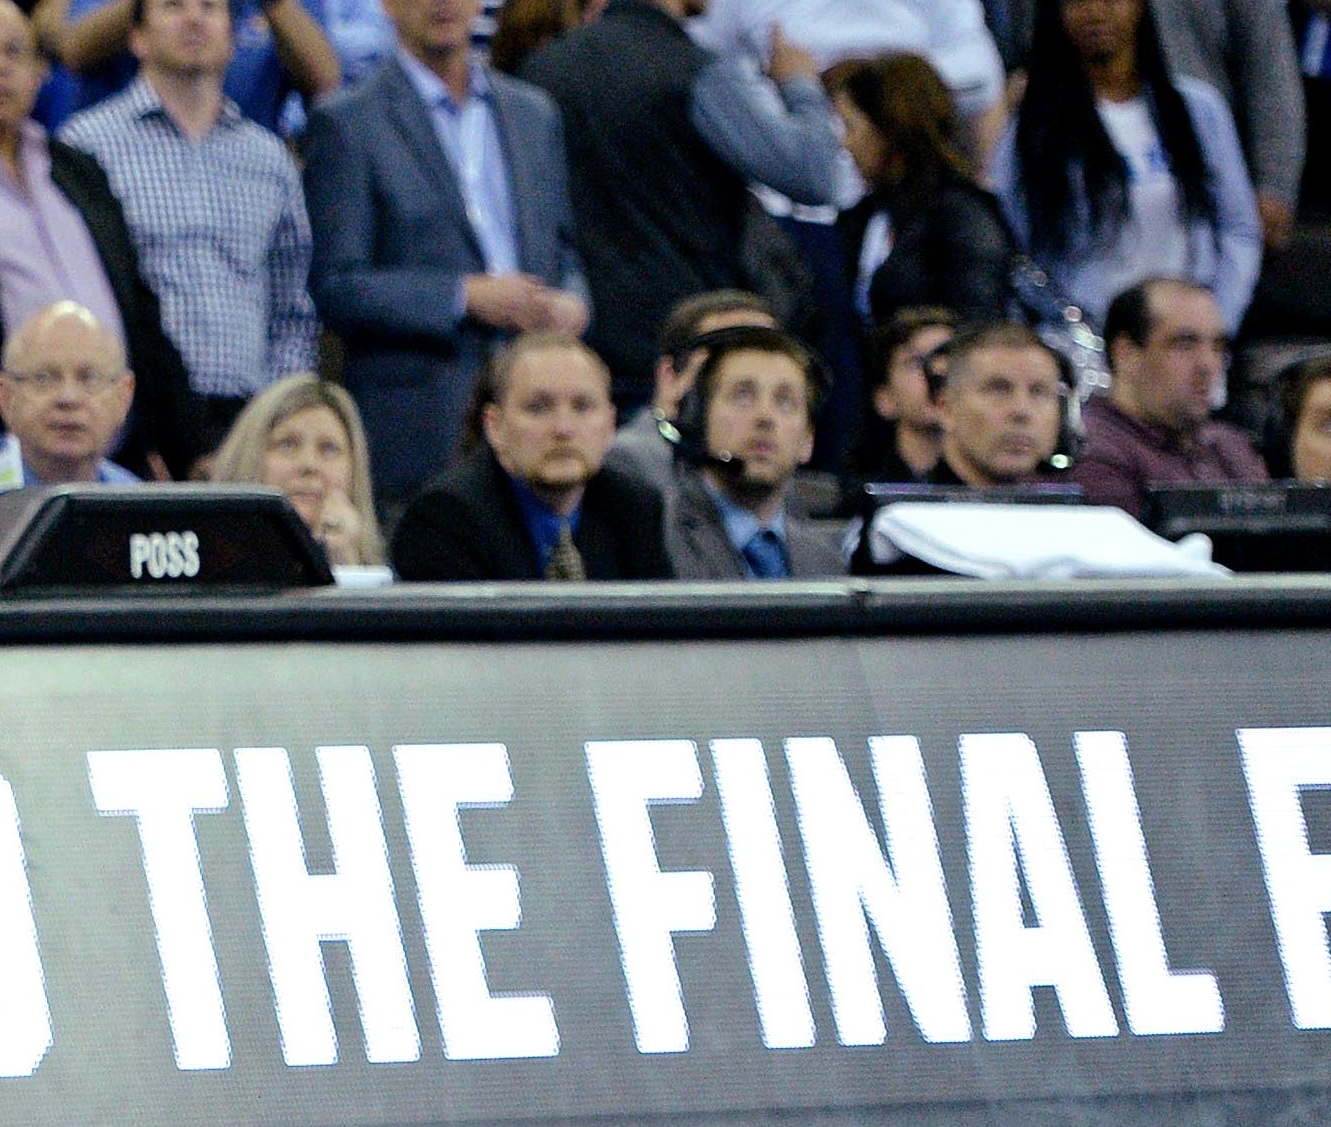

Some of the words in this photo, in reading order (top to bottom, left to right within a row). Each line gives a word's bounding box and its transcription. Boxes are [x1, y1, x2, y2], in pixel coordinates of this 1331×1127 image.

[129, 530, 200, 580] POSS
[89, 744, 558, 1069] THE
[588, 732, 1225, 1053] FINAL
